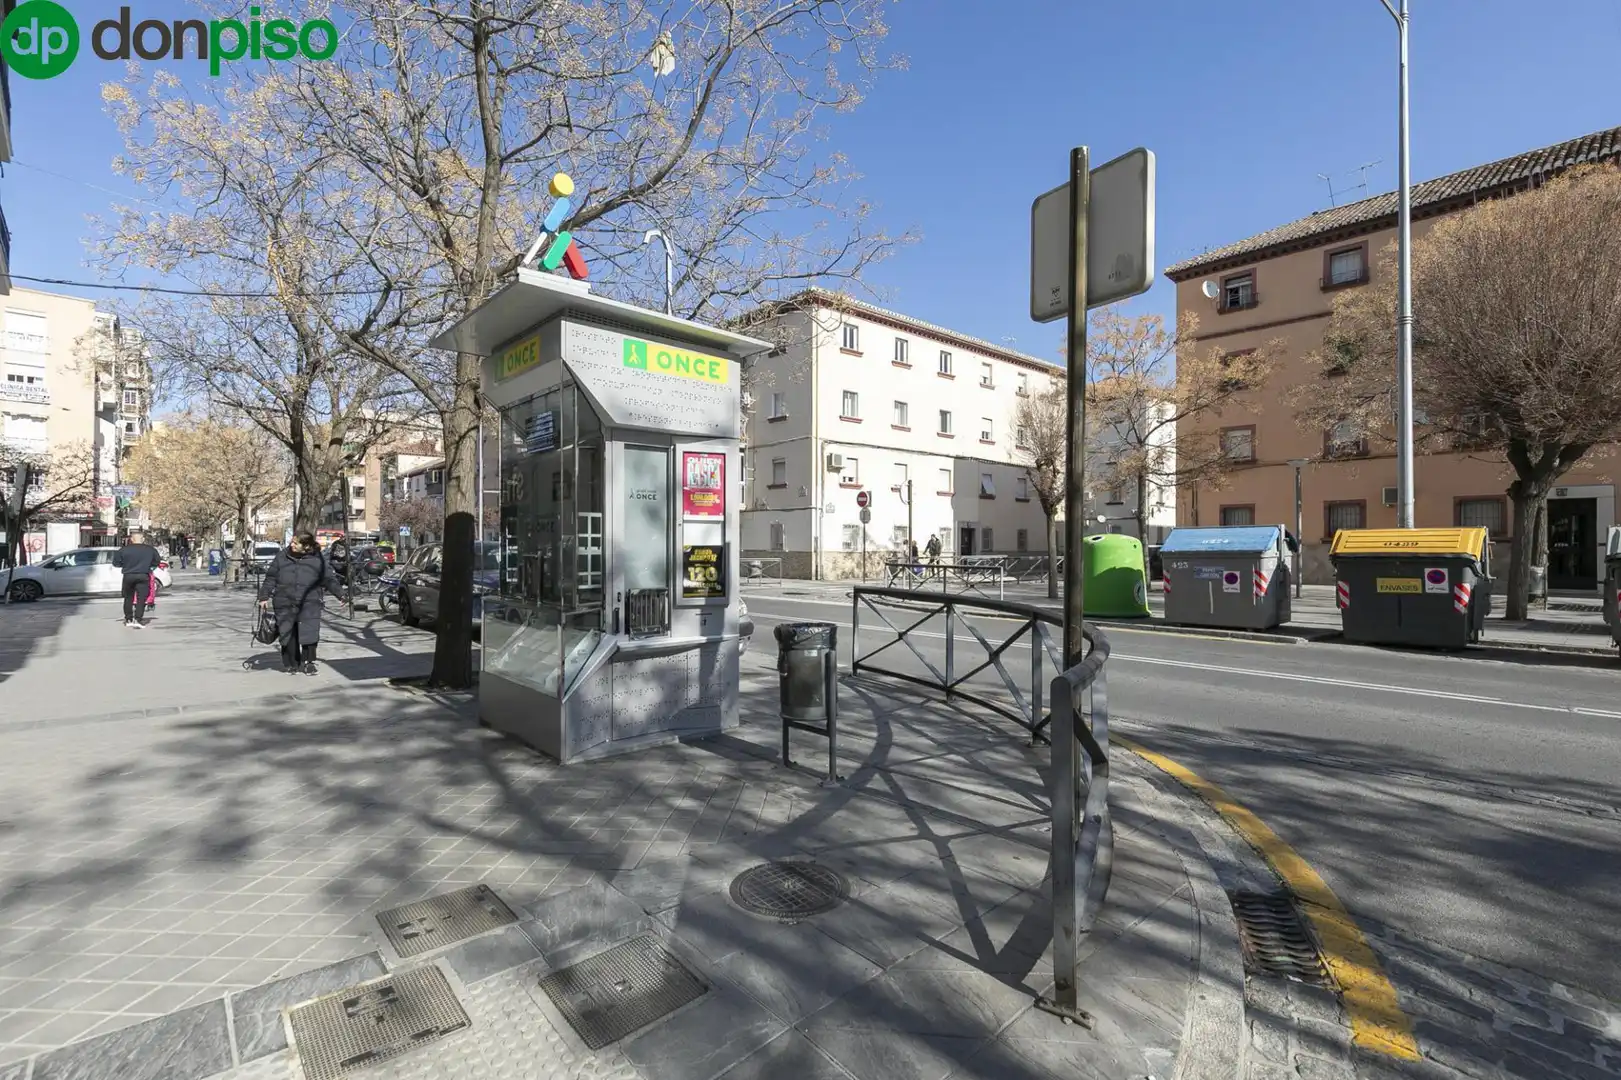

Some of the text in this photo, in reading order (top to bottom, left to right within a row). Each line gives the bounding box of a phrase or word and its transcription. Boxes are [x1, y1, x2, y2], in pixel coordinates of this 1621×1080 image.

[507, 341, 537, 370] ONCE
[657, 351, 721, 379] ONCE
[636, 493, 657, 501] ONCE
[1171, 561, 1189, 569] 423
[688, 566, 718, 582] 120
[1380, 584, 1418, 592] ENVASES
